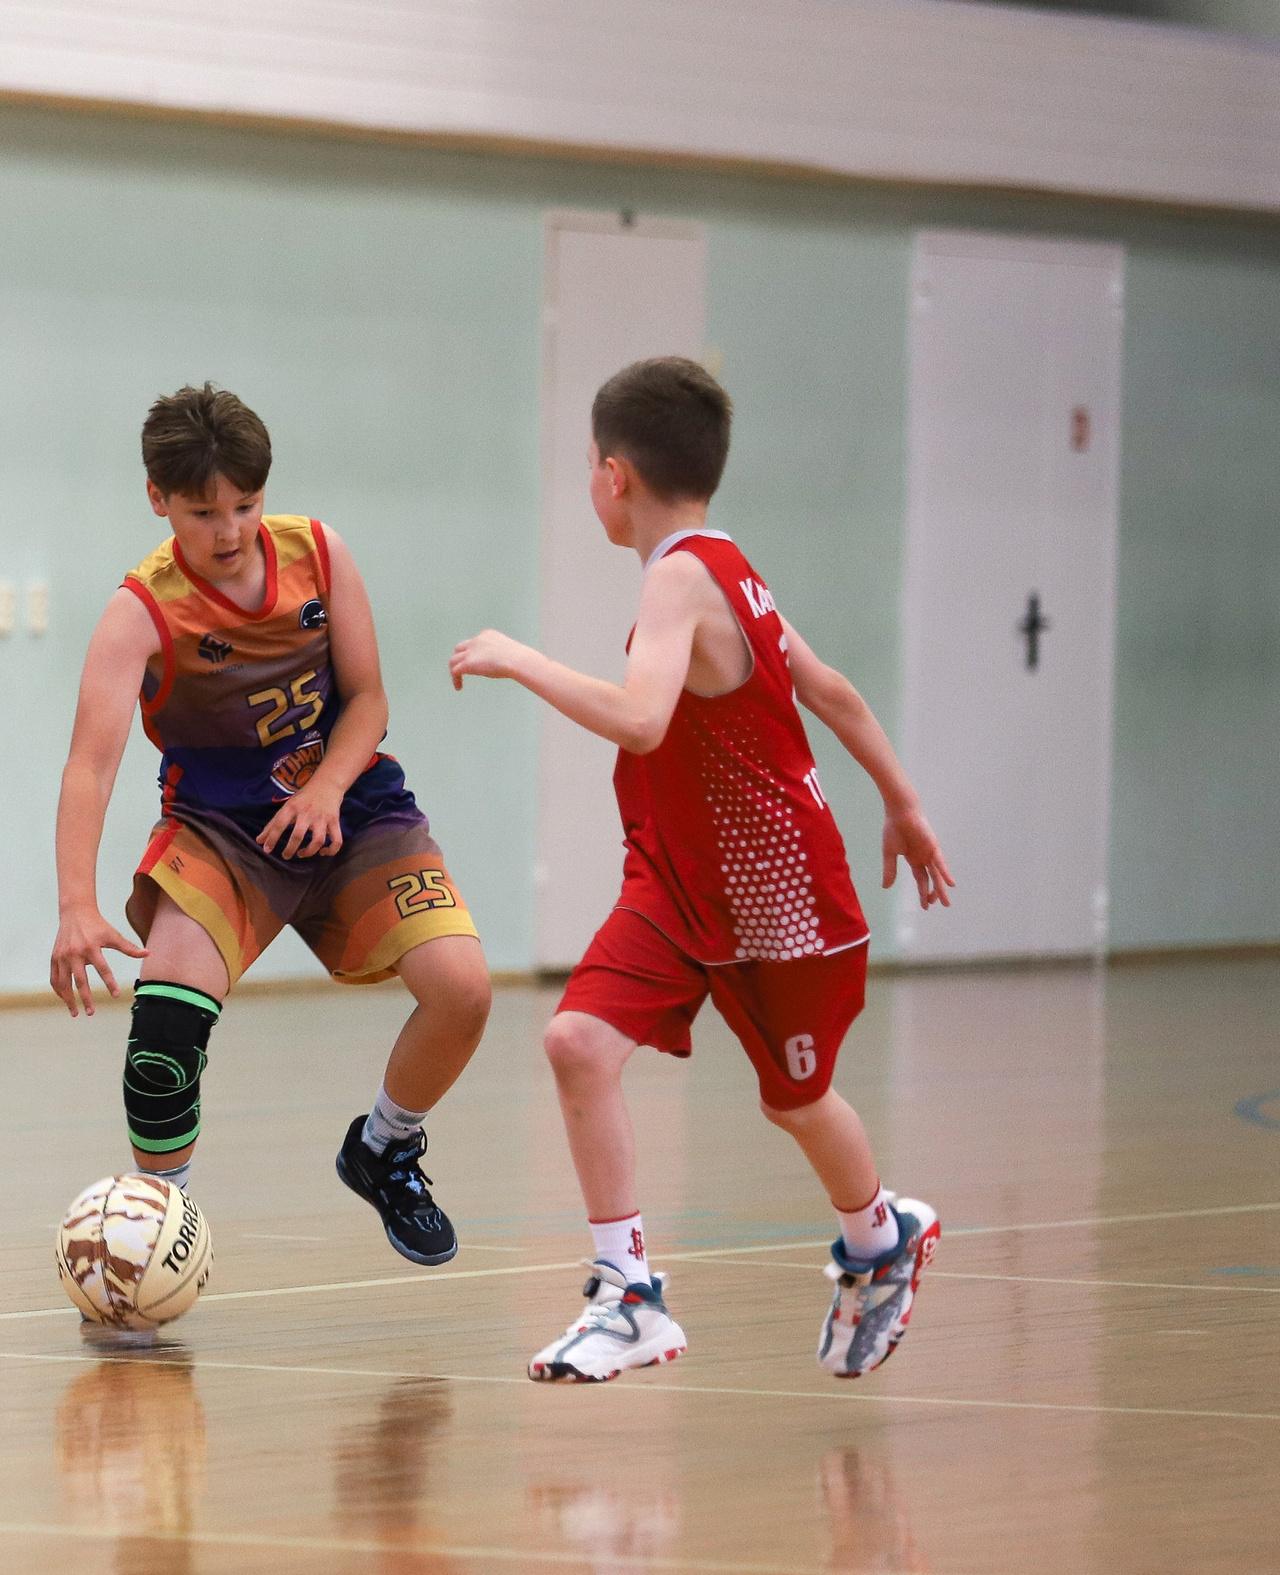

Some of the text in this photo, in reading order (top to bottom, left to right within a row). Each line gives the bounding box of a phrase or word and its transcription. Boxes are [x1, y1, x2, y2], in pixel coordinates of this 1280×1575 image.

[247, 669, 324, 747] 25
[388, 869, 456, 919] 25
[785, 1033, 817, 1081] 6
